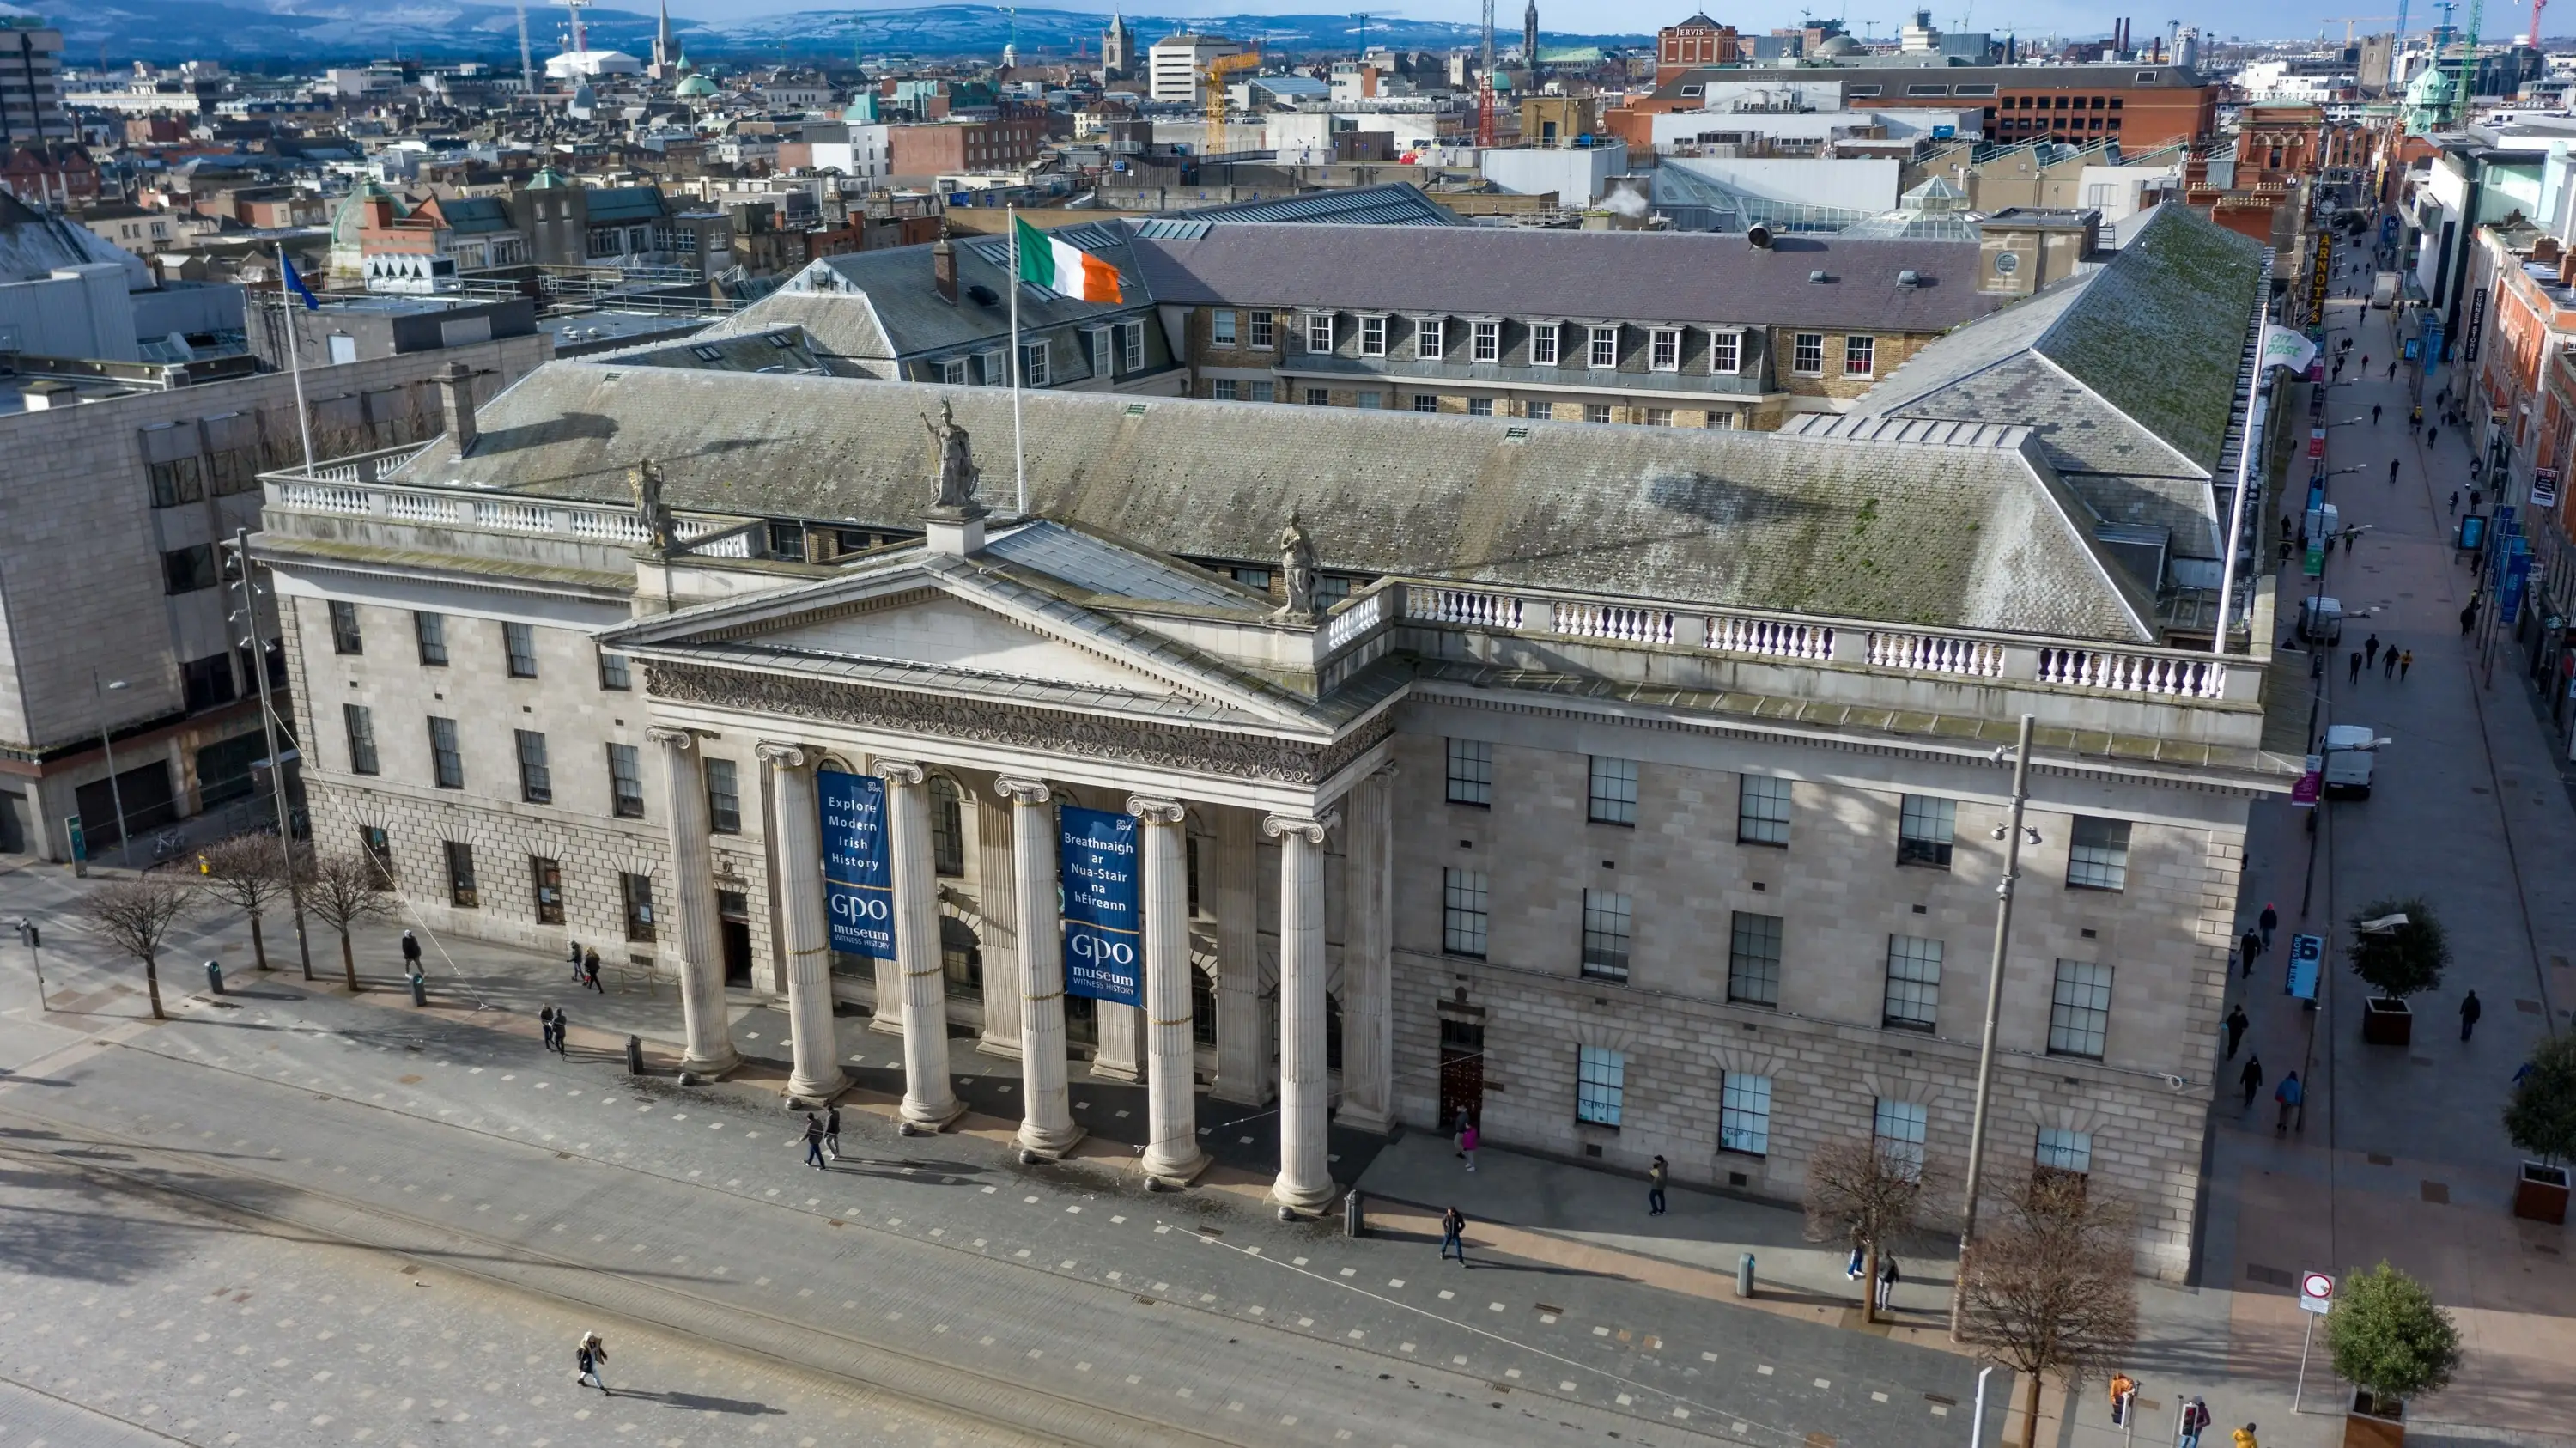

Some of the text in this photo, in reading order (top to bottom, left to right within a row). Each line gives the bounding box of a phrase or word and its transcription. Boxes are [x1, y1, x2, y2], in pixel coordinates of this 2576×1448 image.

[1676, 27, 1704, 38] JERVIS
[2312, 234, 2330, 323] ARNOTTS
[2467, 291, 2483, 359] DUNNES STORES
[2270, 333, 2292, 344] an
[2265, 344, 2303, 357] post
[829, 796, 877, 813] Explore
[829, 815, 878, 832] Modern
[839, 835, 868, 849] Irish
[1064, 832, 1133, 855] Breathnaigh
[832, 852, 878, 871] History
[1091, 855, 1103, 864] ar
[1071, 862, 1127, 883] Nua-Stair
[1091, 884, 1105, 894] na
[1074, 891, 1126, 911] hÉireann
[833, 923, 889, 941] museum
[834, 934, 890, 950] WITNESS HISTORY
[2292, 937, 2302, 958] BOYS
[1072, 965, 1133, 987] museum
[1072, 976, 1134, 995] WITNESS HISTORY
